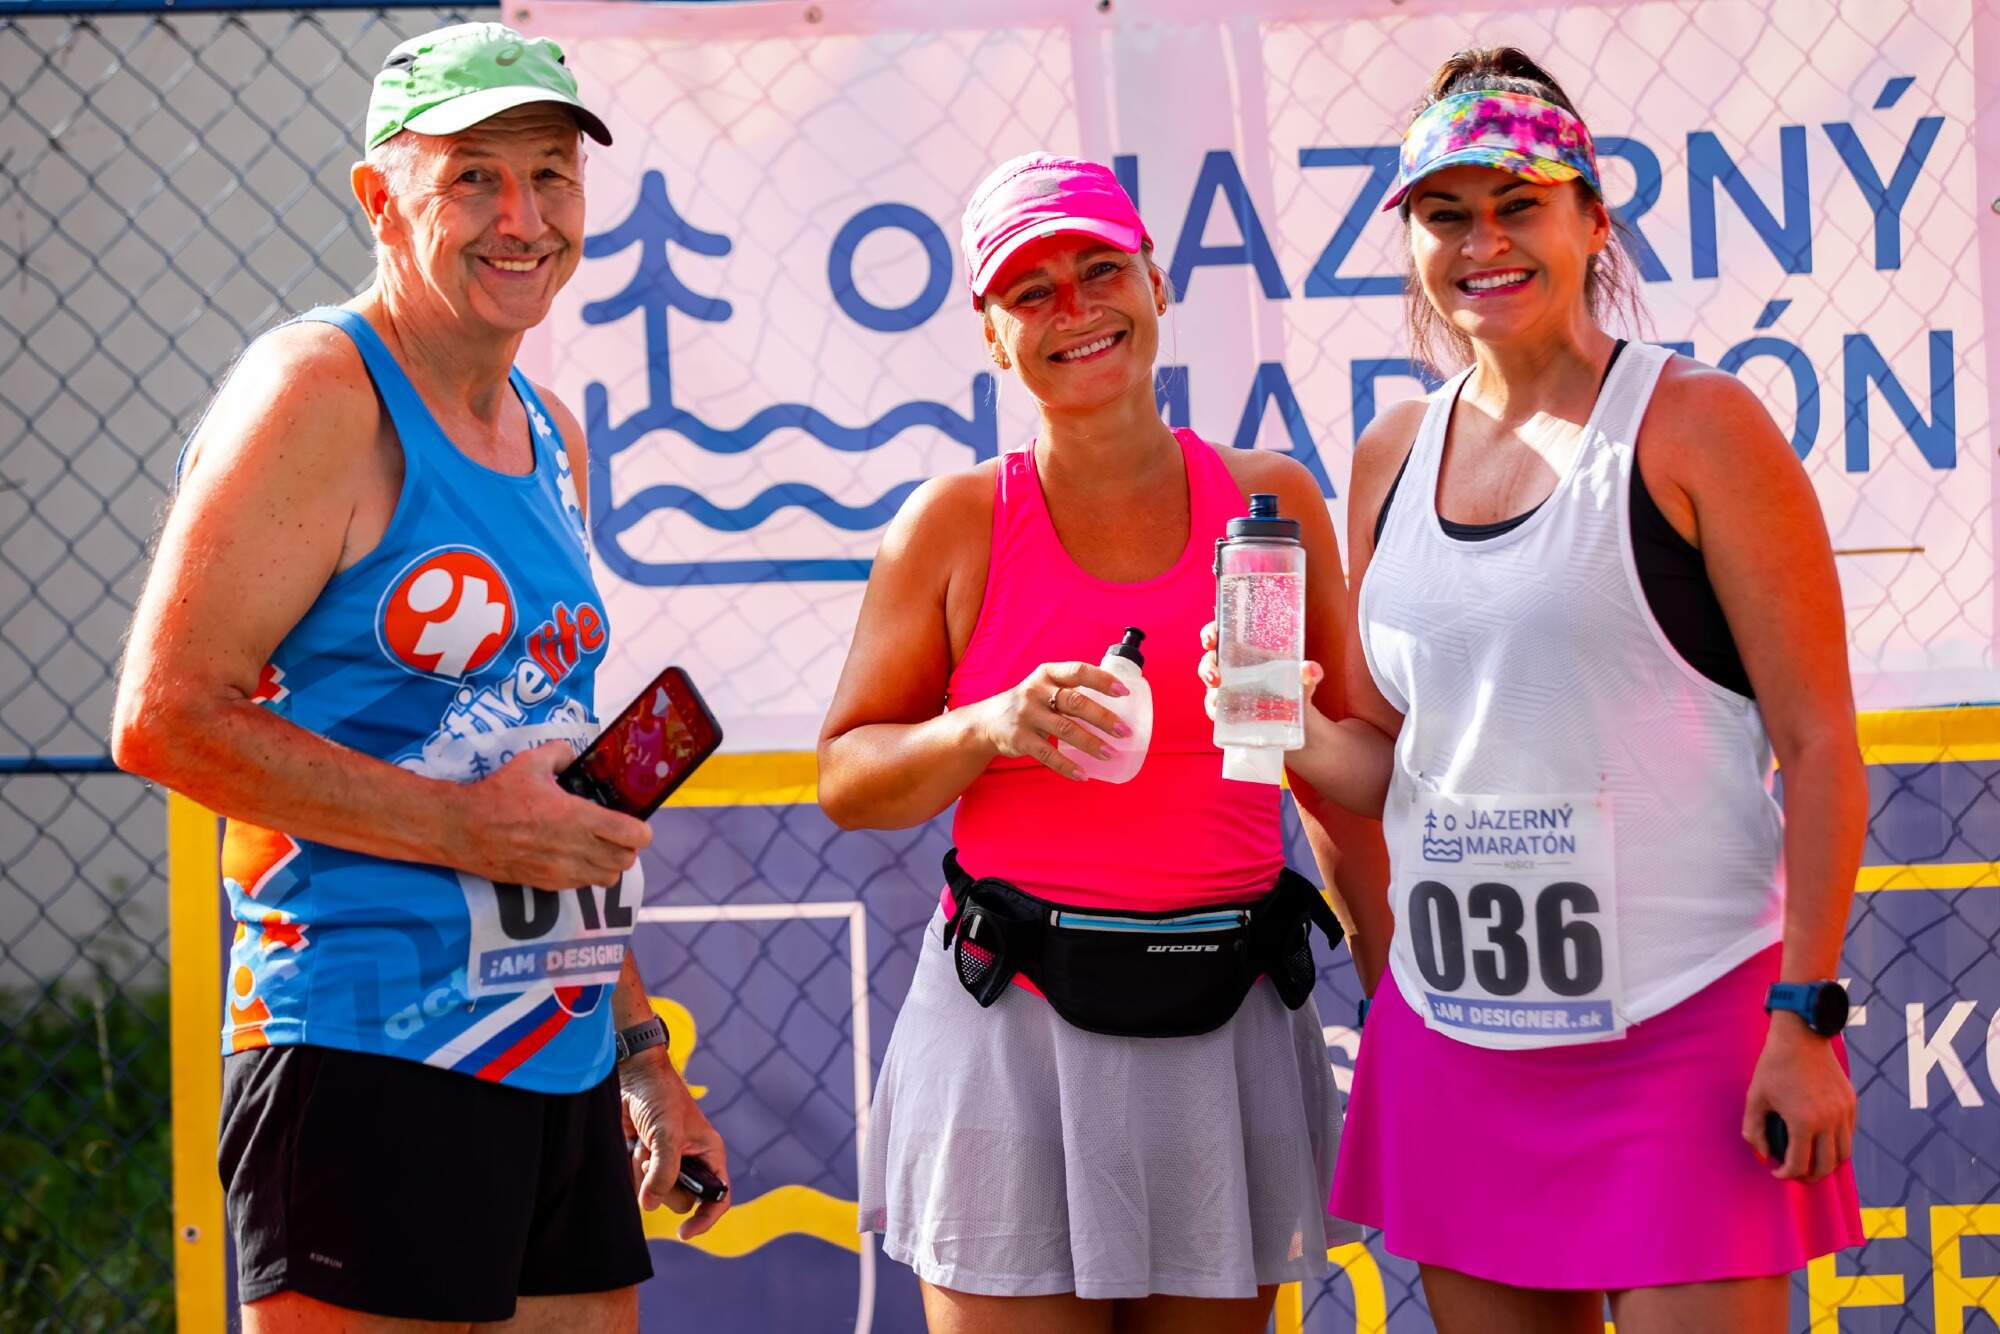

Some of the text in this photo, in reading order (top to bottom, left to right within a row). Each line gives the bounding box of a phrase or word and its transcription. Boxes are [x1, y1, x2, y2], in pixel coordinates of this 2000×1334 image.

[1114, 76, 1946, 303] AZRNÝ
[1465, 803, 1573, 830] JAZERNÝ
[1466, 832, 1576, 855] MARATÓN
[1408, 880, 1604, 997] 036
[1470, 1006, 1603, 1029] DESIGNER.sk
[1905, 1000, 2000, 1109] K
